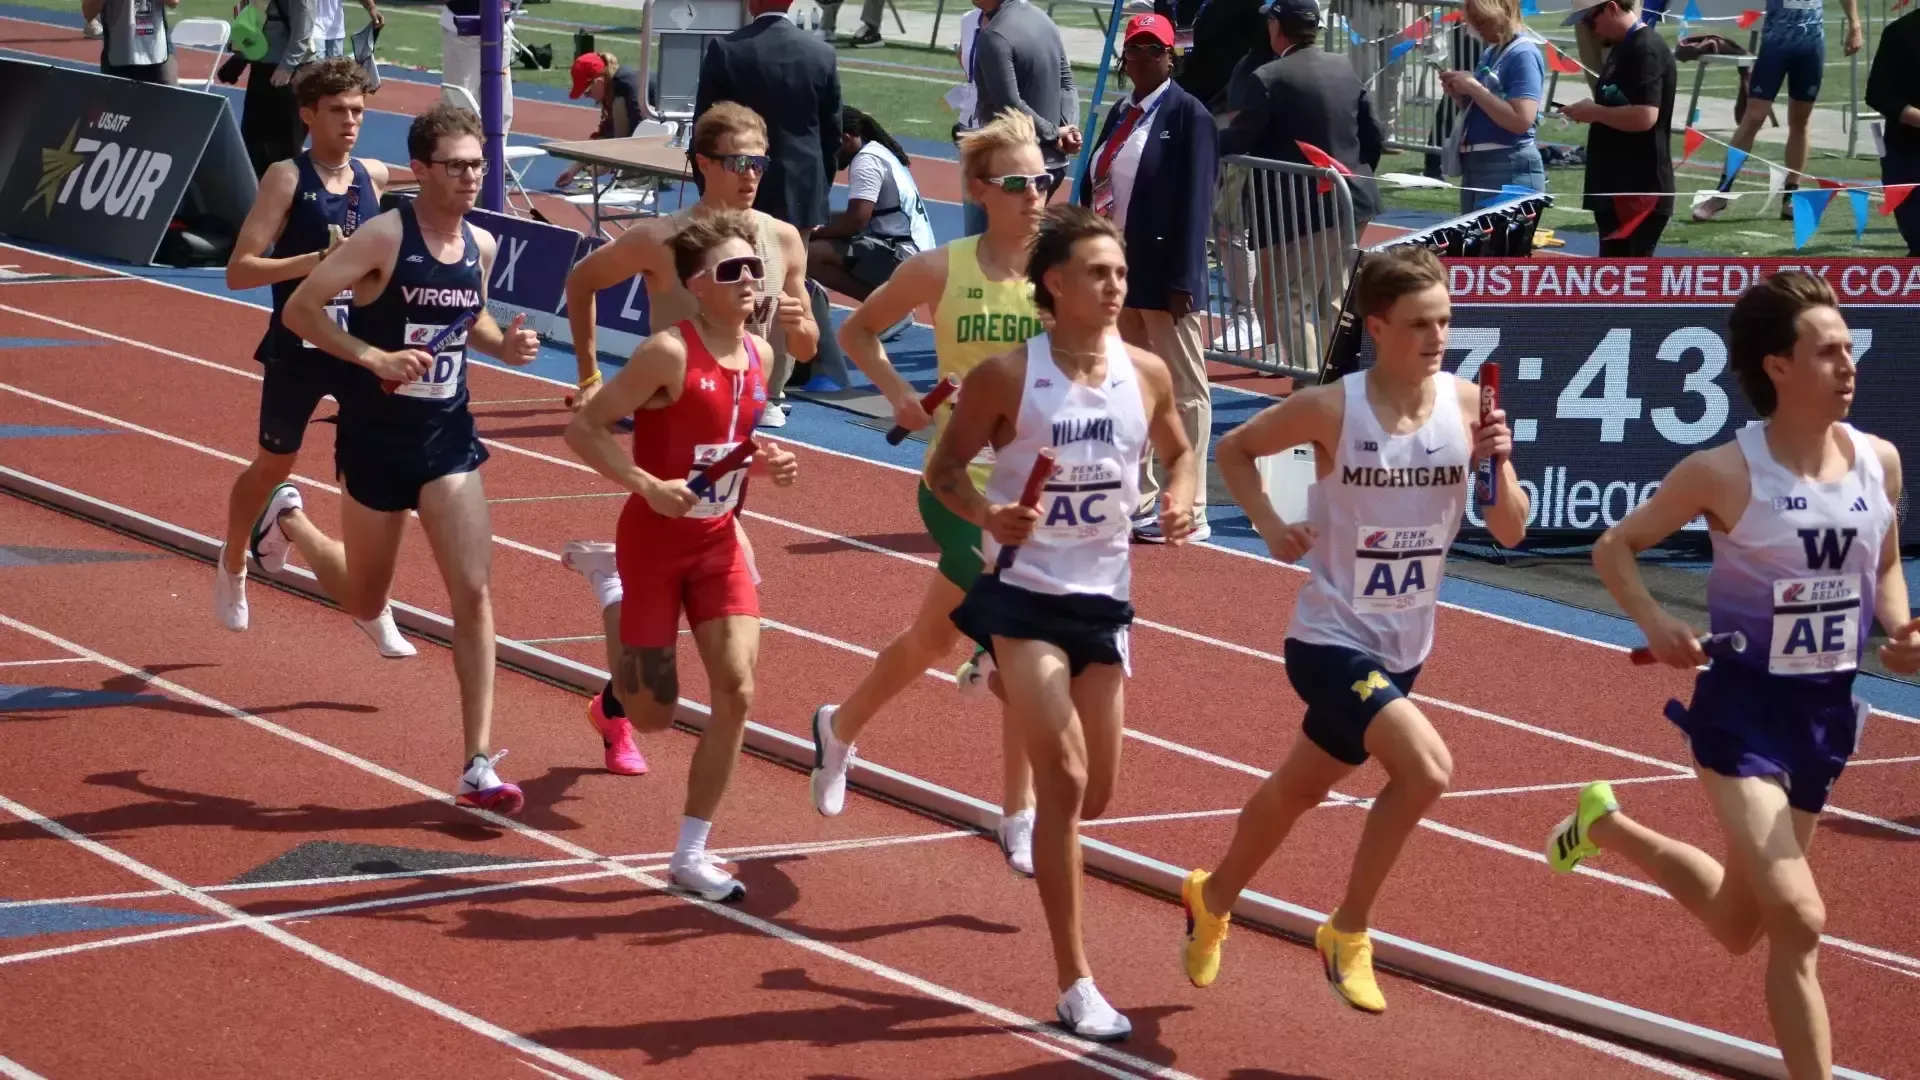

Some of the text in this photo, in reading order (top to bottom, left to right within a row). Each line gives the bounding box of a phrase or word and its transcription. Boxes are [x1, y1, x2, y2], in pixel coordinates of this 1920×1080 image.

[98, 112, 132, 133] USATF
[58, 138, 173, 220] TOUR
[1449, 265, 1649, 296] DISTANCE
[1661, 265, 1830, 296] MEDL
[402, 285, 480, 308] VIRGINIA
[1069, 470, 1113, 482] RELAYS
[1071, 464, 1103, 474] PENN
[1342, 465, 1464, 488] MICHIGAN
[1045, 493, 1107, 526] AC
[1392, 537, 1435, 549] RELAYS
[1394, 530, 1428, 541] PENN
[1797, 528, 1857, 570] W
[1363, 559, 1426, 597] AA
[1812, 580, 1844, 591] PENN
[1811, 587, 1852, 601] RELAYS
[1782, 614, 1846, 655] AE
[1350, 670, 1389, 702] M
